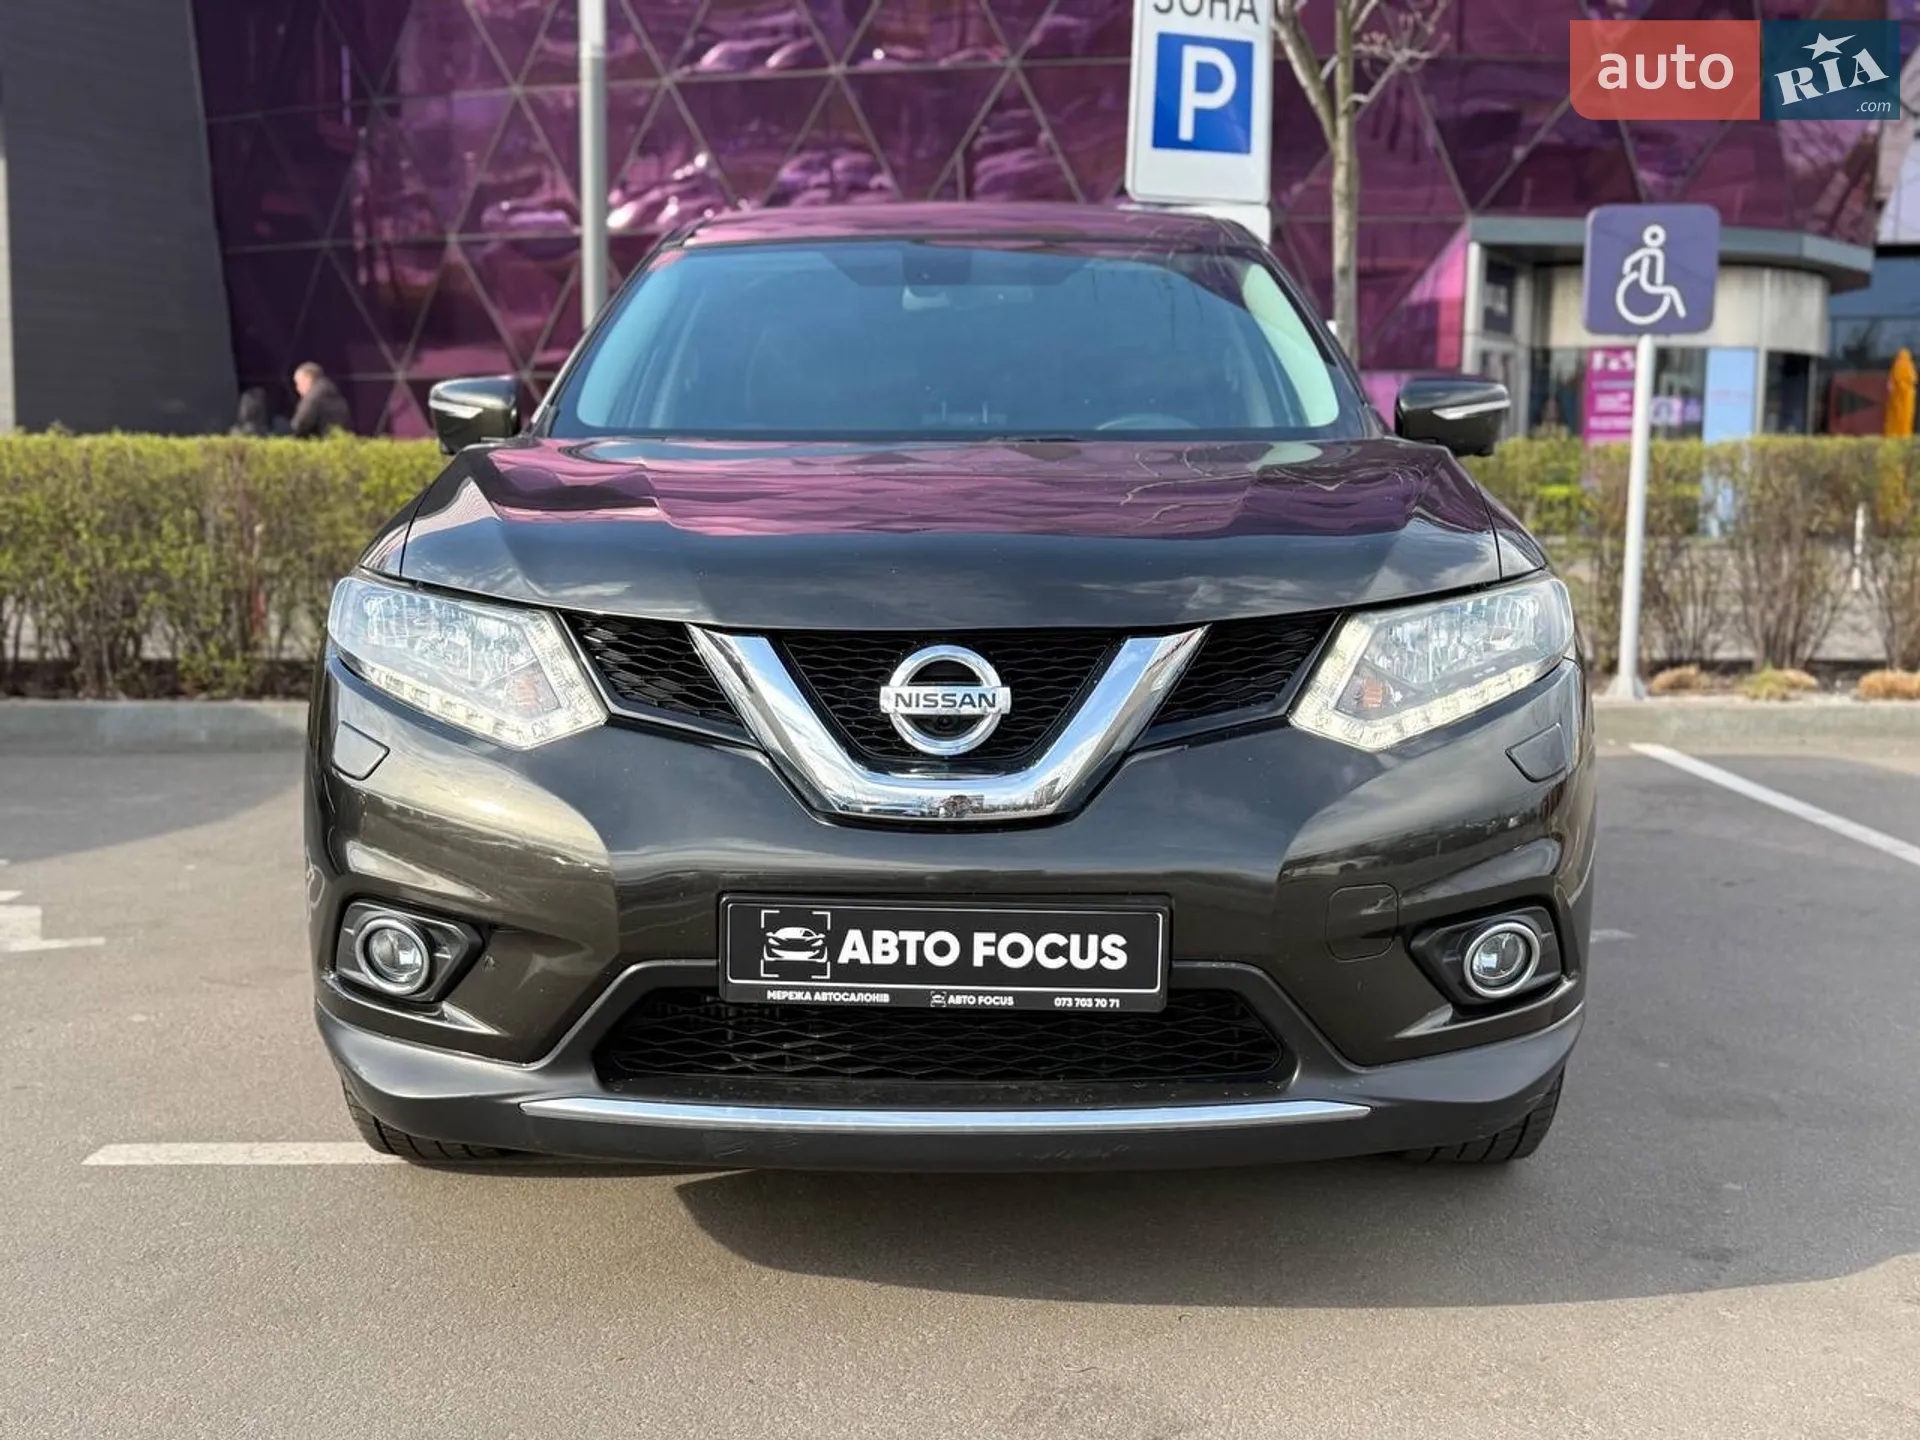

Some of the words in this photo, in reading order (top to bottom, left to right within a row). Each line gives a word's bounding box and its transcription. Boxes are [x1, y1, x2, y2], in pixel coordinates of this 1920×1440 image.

[1178, 44, 1238, 142] P
[894, 692, 997, 709] NISSAN
[837, 929, 961, 967] АВТО
[972, 931, 1128, 970] FOCUS
[766, 990, 812, 1001] МЕРЕЖА
[813, 991, 890, 1004] АВТОСАЛОНІВ
[948, 995, 976, 1005] АВТО
[978, 995, 1014, 1006] FOCUS
[1054, 997, 1073, 1008] 073
[1094, 998, 1108, 1009] 70
[1109, 998, 1120, 1009] 71
